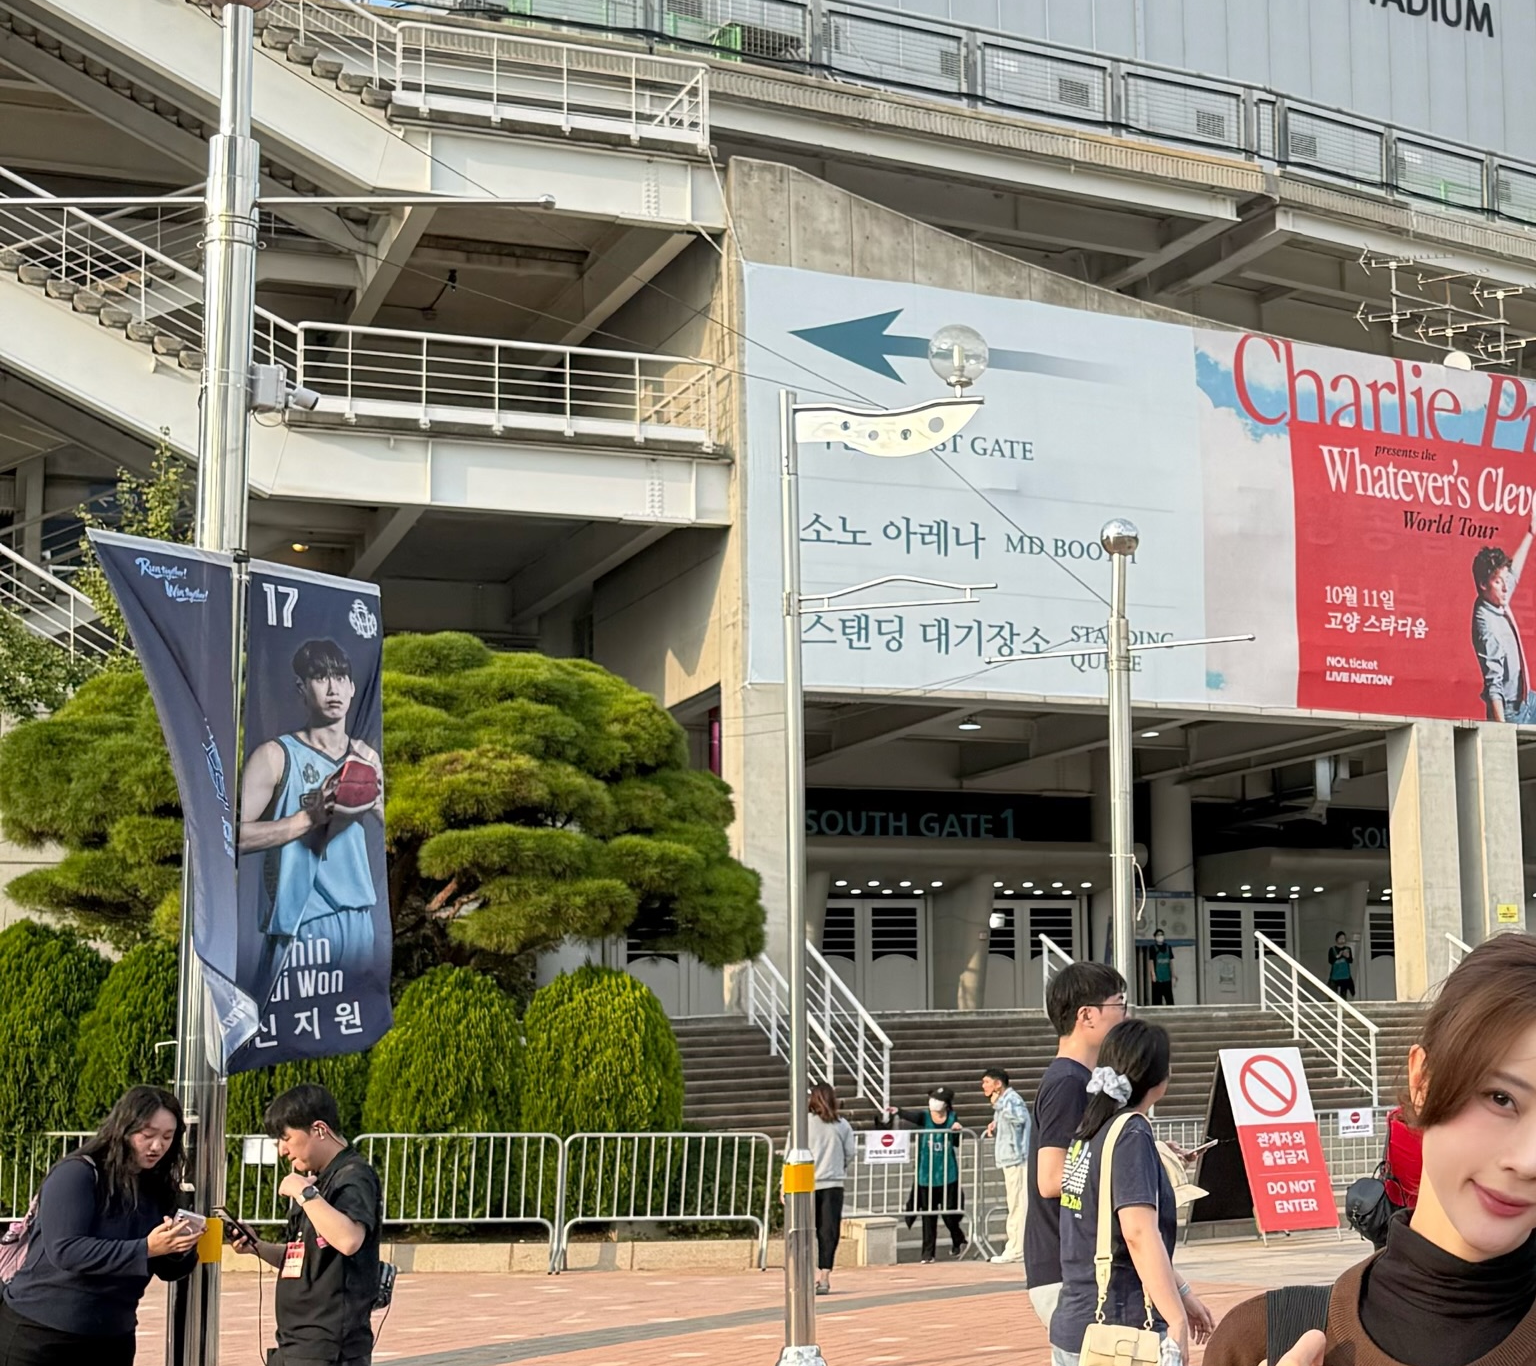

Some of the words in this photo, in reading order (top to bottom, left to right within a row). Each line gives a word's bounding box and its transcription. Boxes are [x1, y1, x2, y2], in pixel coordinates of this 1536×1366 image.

[1233, 333, 1463, 444] Charlie
[970, 436, 1034, 461] GATE
[1421, 448, 1437, 461] the
[1318, 444, 1471, 510] Whatever's
[800, 513, 871, 546] 소노
[882, 516, 986, 560] 아레나
[1403, 510, 1454, 534] World
[1458, 517, 1499, 540] Tour
[1005, 533, 1045, 556] MD
[1053, 538, 1137, 565] BOO
[262, 582, 299, 629] 17
[1325, 585, 1359, 607] 10월
[1362, 589, 1395, 611] 11일
[801, 613, 904, 652] 스탠딩
[920, 616, 1050, 658] 대기장소
[1071, 625, 1174, 649] STADING
[1324, 611, 1361, 633] 고양
[1362, 615, 1429, 639] 스타디움
[1326, 670, 1349, 683] LIVE
[1350, 672, 1393, 686] NATION
[1349, 657, 1379, 670] ticket
[805, 810, 908, 837] SOUTH
[918, 812, 994, 838] GATE
[1001, 808, 1015, 839] 1
[287, 933, 331, 969] hin
[297, 969, 344, 999] Won
[1262, 1148, 1310, 1166] 출입금지
[1266, 1181, 1288, 1195] DO
[1288, 1179, 1316, 1194] NOT
[1274, 1198, 1319, 1214] ENTER
